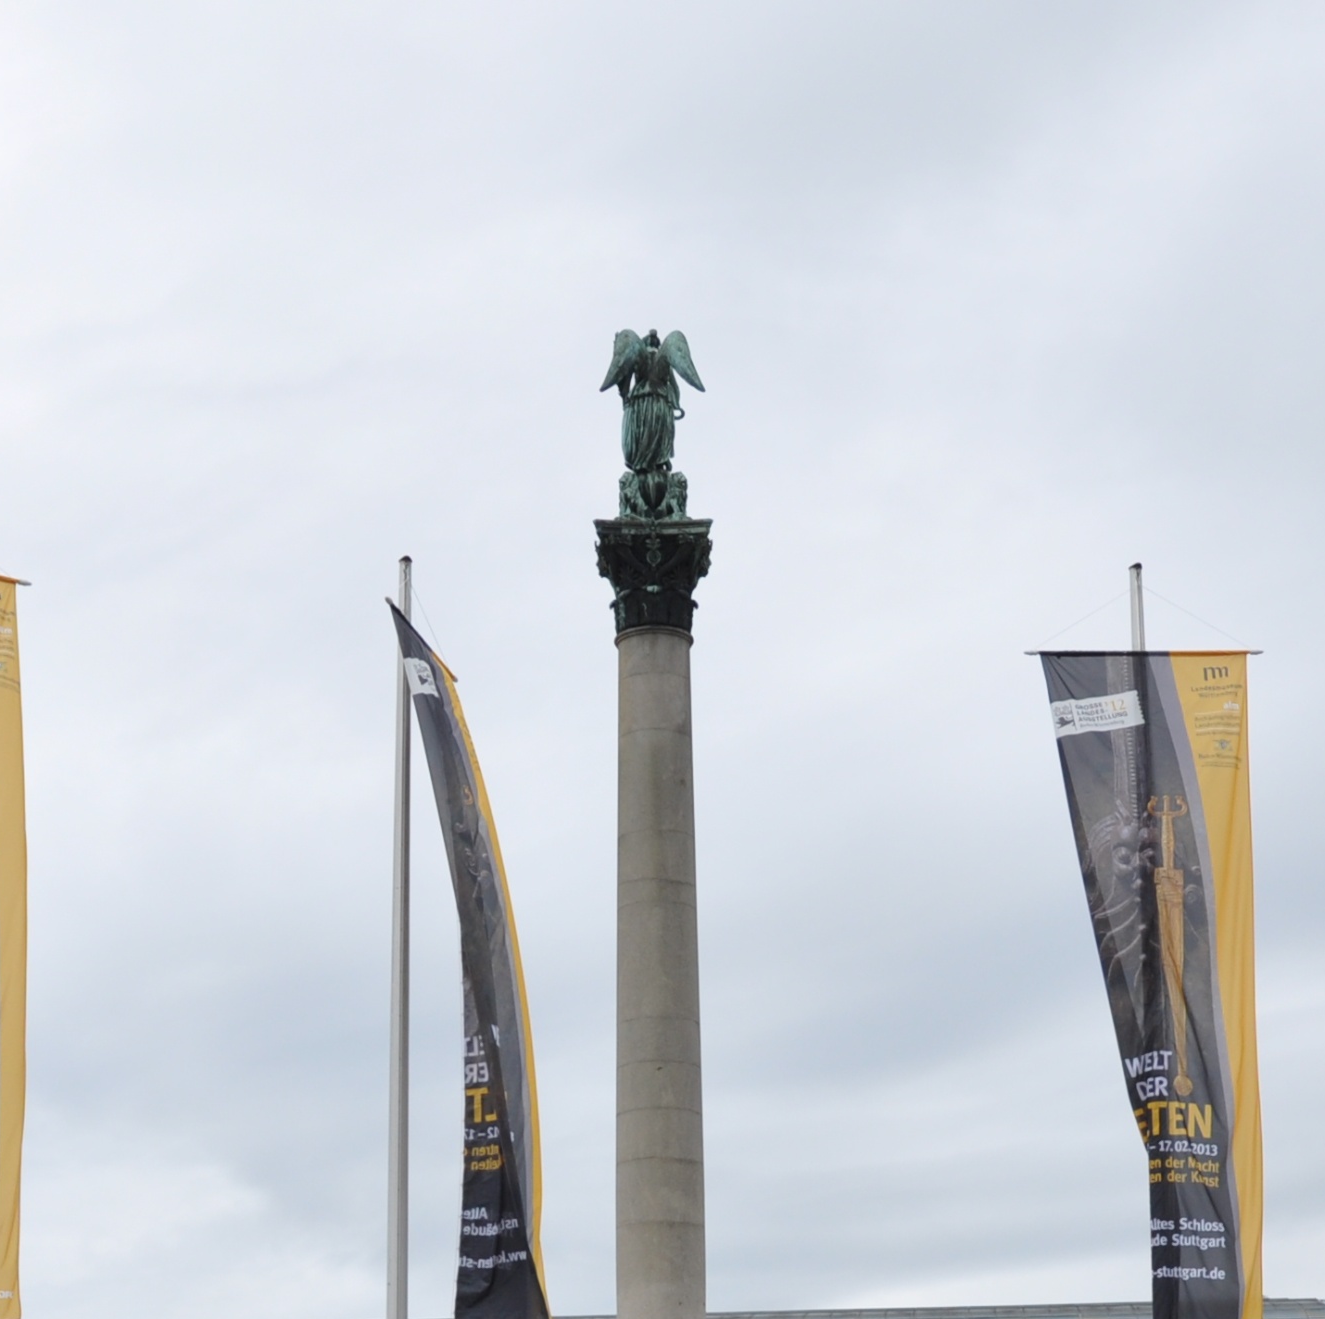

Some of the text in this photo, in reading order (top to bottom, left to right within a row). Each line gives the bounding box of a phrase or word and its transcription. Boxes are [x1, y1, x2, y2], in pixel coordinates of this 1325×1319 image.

[1124, 1050, 1172, 1078] WELT
[1136, 1076, 1169, 1101] DER
[1165, 1157, 1186, 1168] der
[1167, 1171, 1186, 1183] der
[1179, 1218, 1225, 1232] Schloss
[1171, 1234, 1226, 1250] Stuttgart
